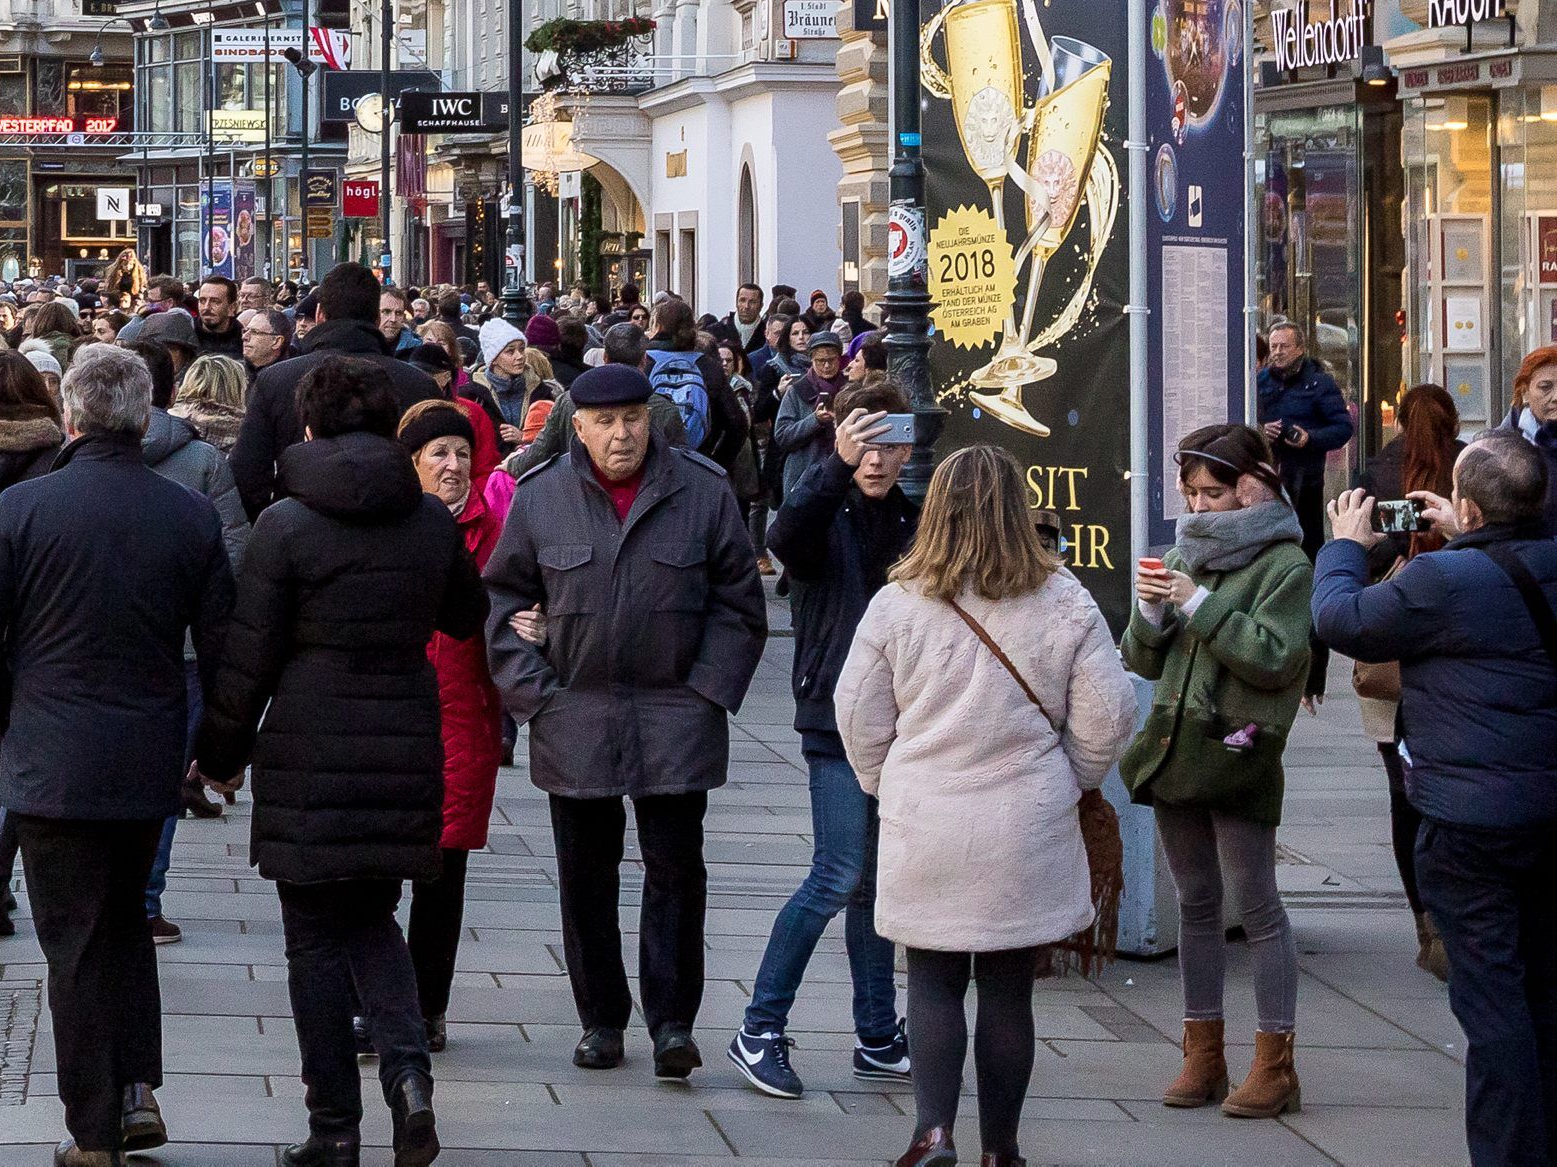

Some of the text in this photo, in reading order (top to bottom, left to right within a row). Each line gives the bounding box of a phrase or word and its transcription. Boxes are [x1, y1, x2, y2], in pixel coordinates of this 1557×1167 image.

[431, 98, 473, 116] IWC
[86, 118, 117, 133] 2017
[212, 118, 267, 129] RZEŚNIEWSK
[251, 164, 279, 172] FOSIL
[346, 186, 376, 199] högl
[958, 226, 970, 236] DIE
[936, 234, 996, 249] NEUJAHRSMÜNZE
[939, 249, 995, 283] 2018
[941, 283, 996, 298] ERHÄLTLICH AM
[938, 293, 1002, 309] STAND DER MÜNZE
[942, 305, 998, 319] ÖSTERREICH AG
[950, 317, 991, 328] AM GRABEN
[1025, 466, 1088, 510] SIT
